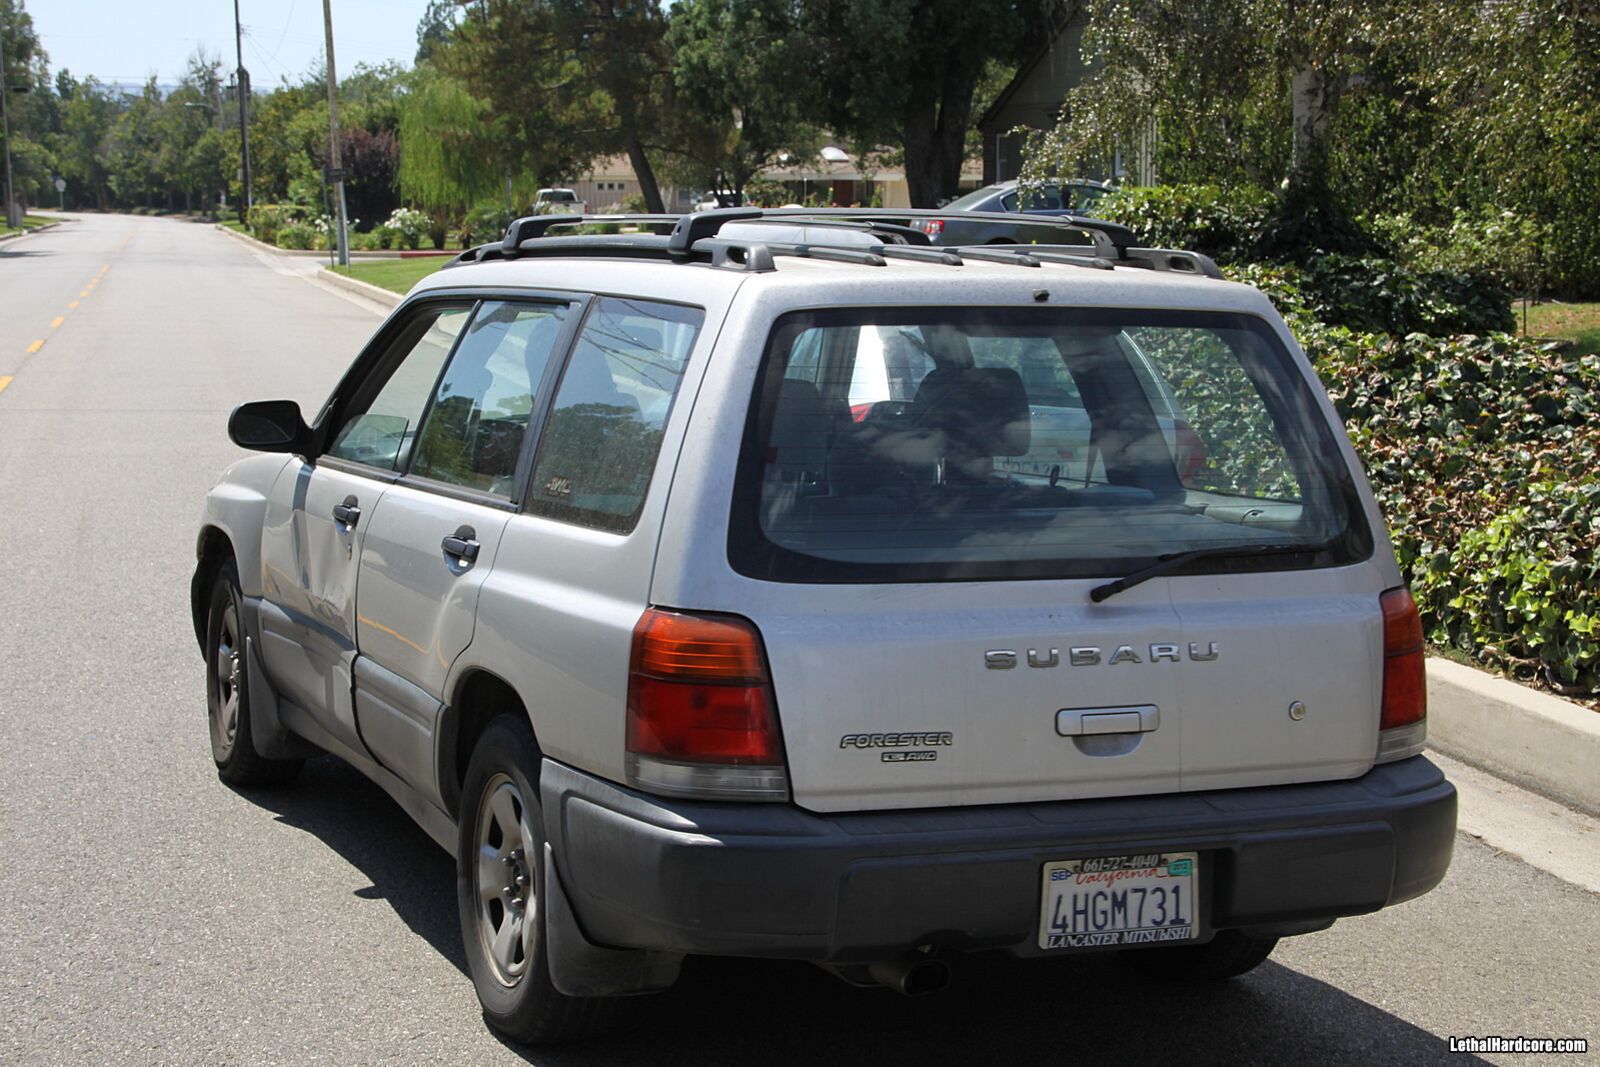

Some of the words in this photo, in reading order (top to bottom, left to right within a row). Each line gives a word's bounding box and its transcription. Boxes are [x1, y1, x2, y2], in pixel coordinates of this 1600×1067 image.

[984, 641, 1219, 669] SUBARU
[840, 732, 952, 749] FORESTER
[1075, 868, 1168, 888] California
[1051, 884, 1186, 934] 4HGM731
[1048, 932, 1119, 949] LANCASTER
[1121, 926, 1191, 944] MITSUBISHI
